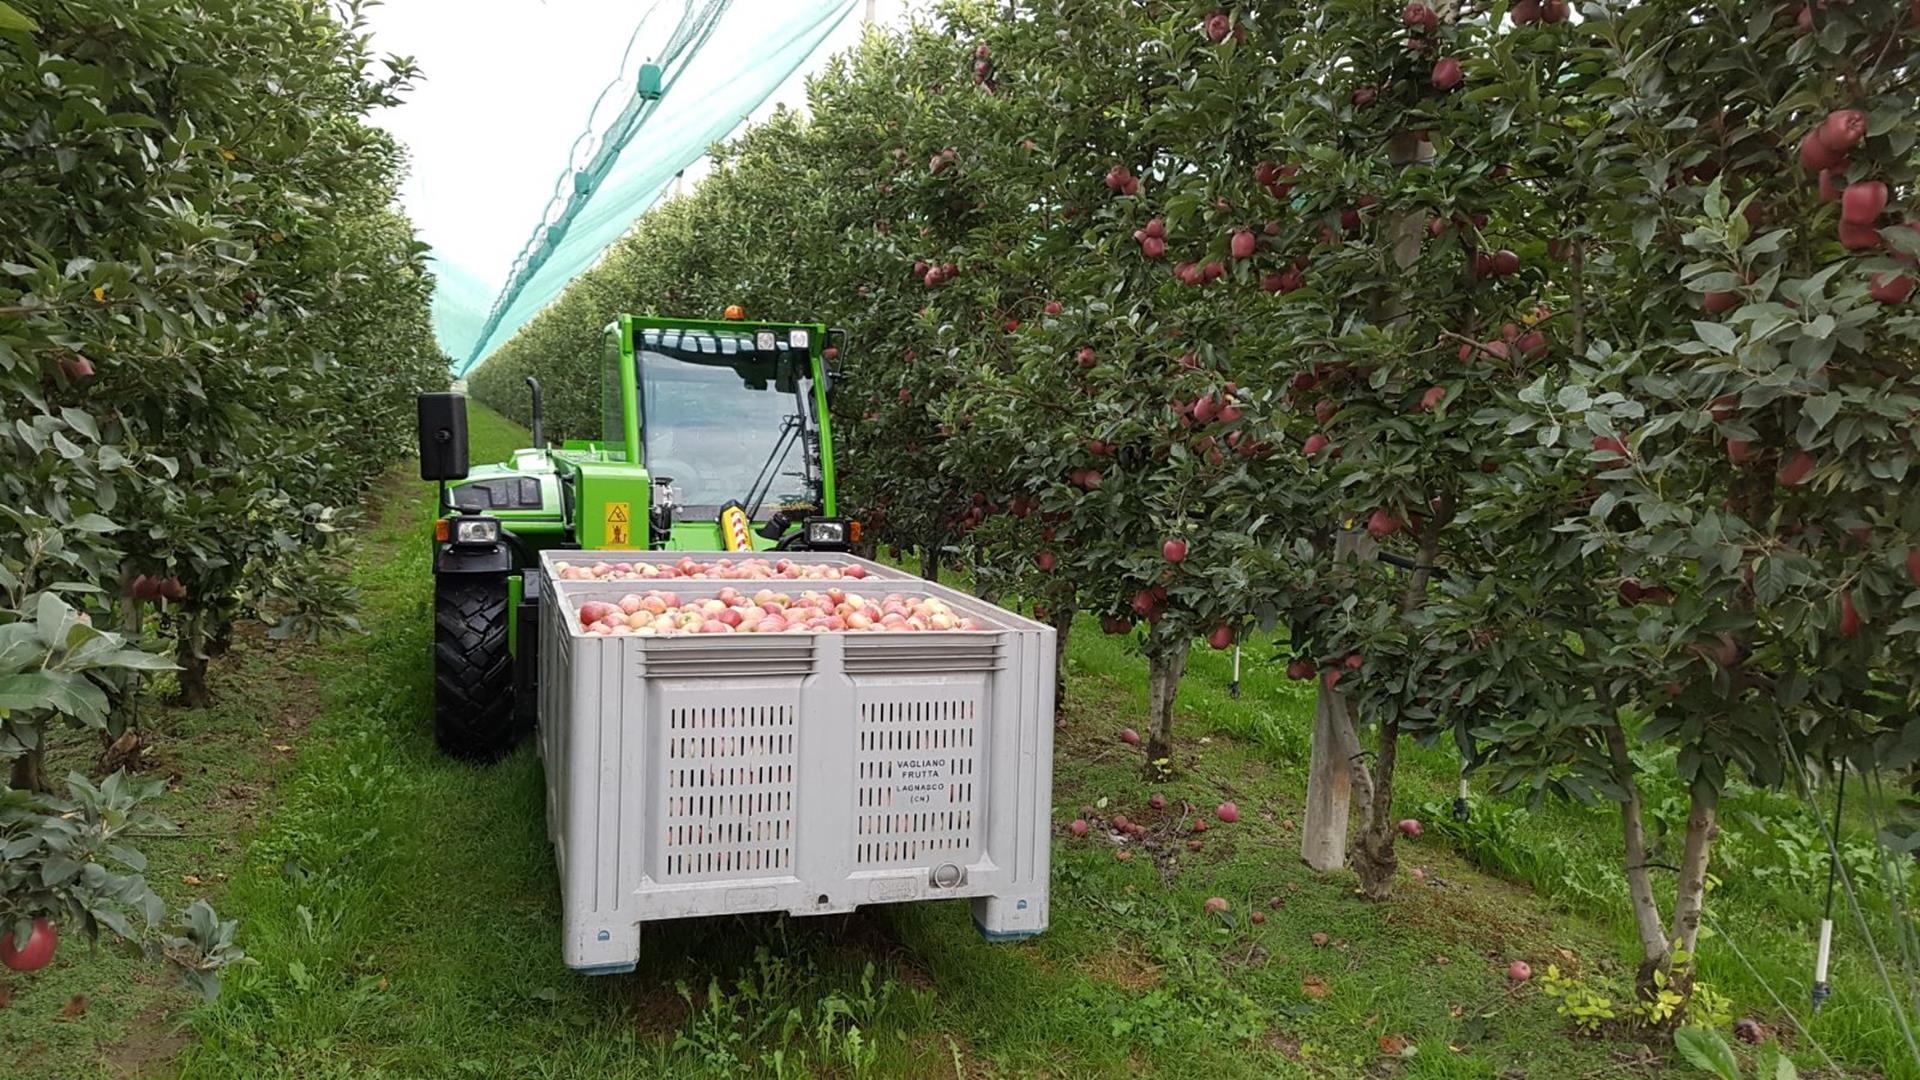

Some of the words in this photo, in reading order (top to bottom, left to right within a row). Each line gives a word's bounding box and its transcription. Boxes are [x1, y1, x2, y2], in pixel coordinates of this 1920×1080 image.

[897, 759, 946, 768] VAGLIANO
[902, 770, 939, 778] FRUTTA
[896, 783, 945, 792] LAGNASCO
[910, 795, 930, 804] (CN)
